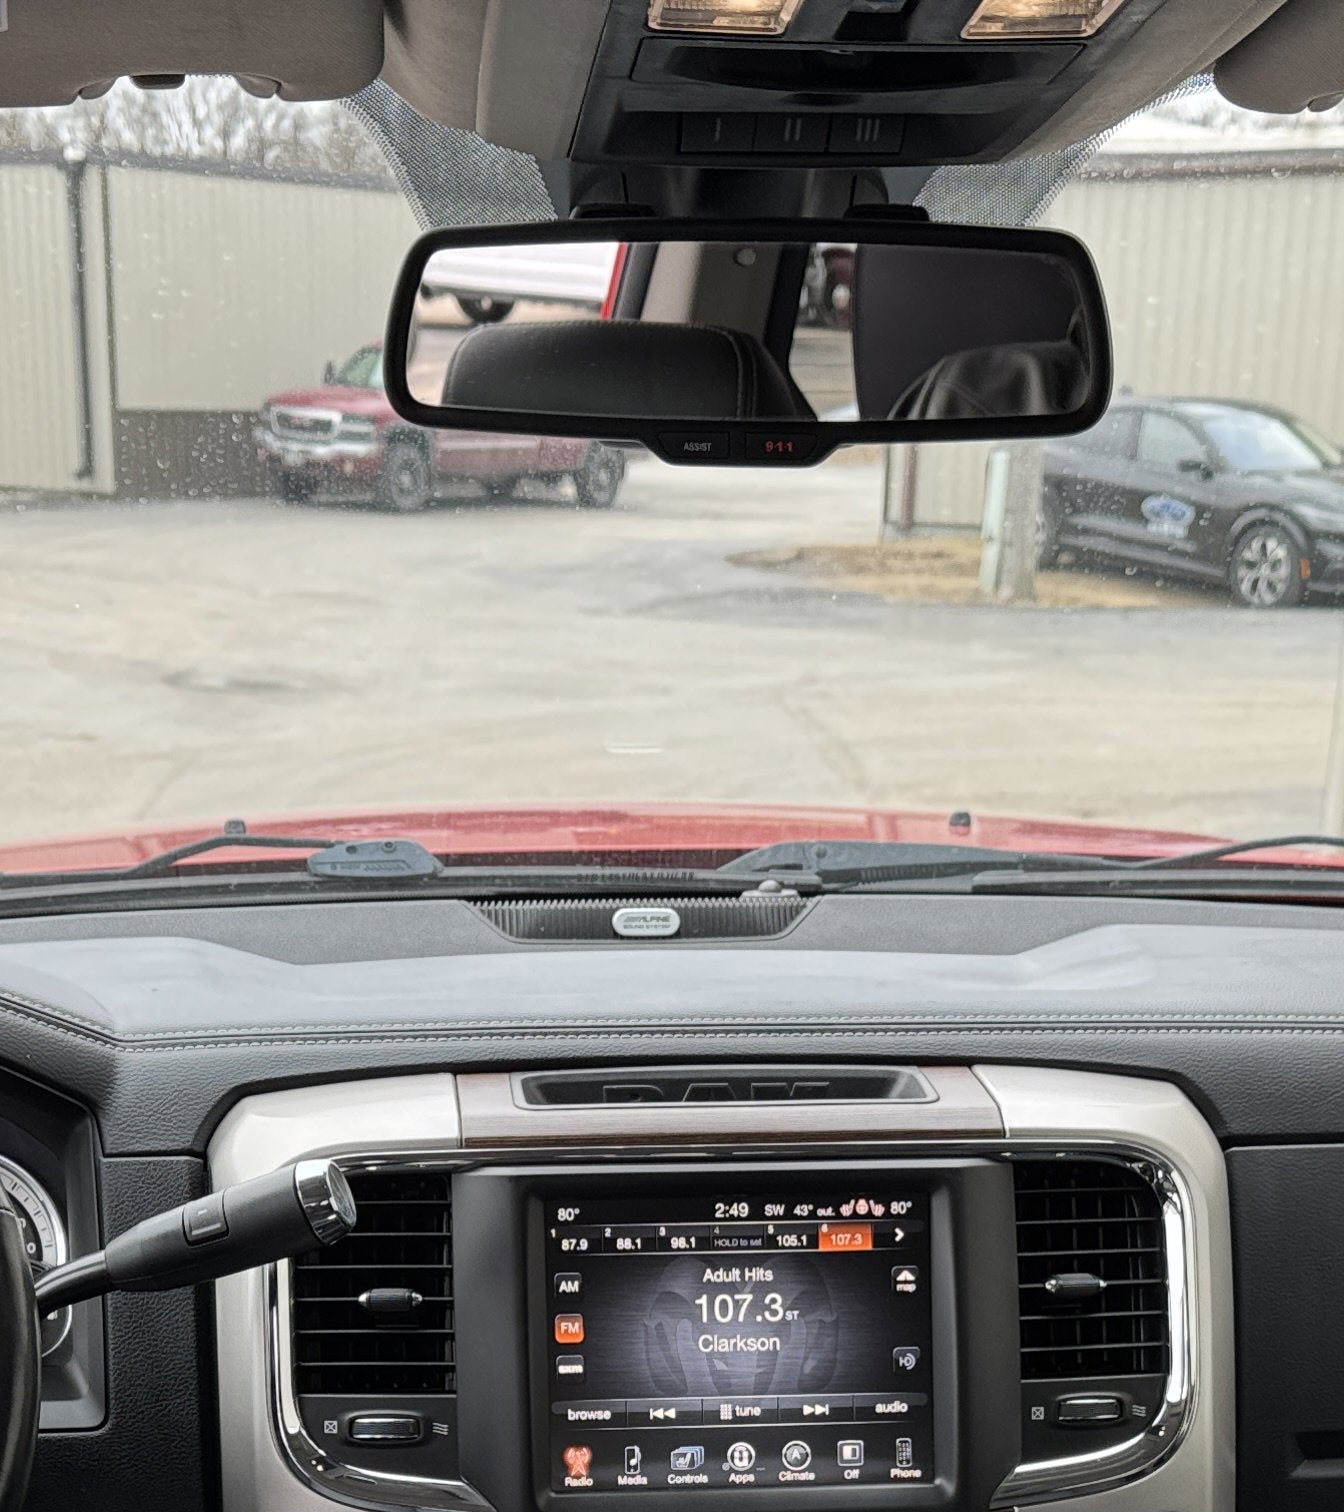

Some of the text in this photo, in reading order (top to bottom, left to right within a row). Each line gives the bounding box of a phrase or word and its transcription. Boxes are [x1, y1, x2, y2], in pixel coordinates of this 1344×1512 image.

[684, 442, 712, 451] ASSIST
[557, 1208, 580, 1221] 80°
[715, 1202, 749, 1218] 2:49
[765, 1204, 785, 1216] SW
[793, 1204, 813, 1216] 43°
[890, 1201, 912, 1214] 80°
[605, 1228, 611, 1237] 2
[659, 1227, 666, 1236] 3
[561, 1239, 588, 1251] 87.9
[616, 1238, 641, 1249] 88.1
[671, 1236, 696, 1248] 98.1
[714, 1237, 738, 1247] HOLD
[740, 1238, 748, 1246] to
[776, 1234, 807, 1247] 105.1
[830, 1233, 863, 1245] 107.3
[702, 1267, 774, 1282] Adult Hits
[559, 1280, 579, 1293] AM
[695, 1293, 799, 1323] 107.3 ST
[560, 1322, 579, 1334] FM
[698, 1334, 780, 1353] Clarkson
[735, 1405, 761, 1417] tune
[875, 1400, 908, 1413] audio
[567, 1408, 612, 1421] browse
[667, 1473, 708, 1484] Controls
[728, 1472, 755, 1484] Apps
[778, 1471, 815, 1482] Climate
[844, 1469, 860, 1480] Off
[890, 1468, 922, 1479] Phone
[564, 1476, 593, 1487] Radio
[617, 1475, 648, 1486] Media
